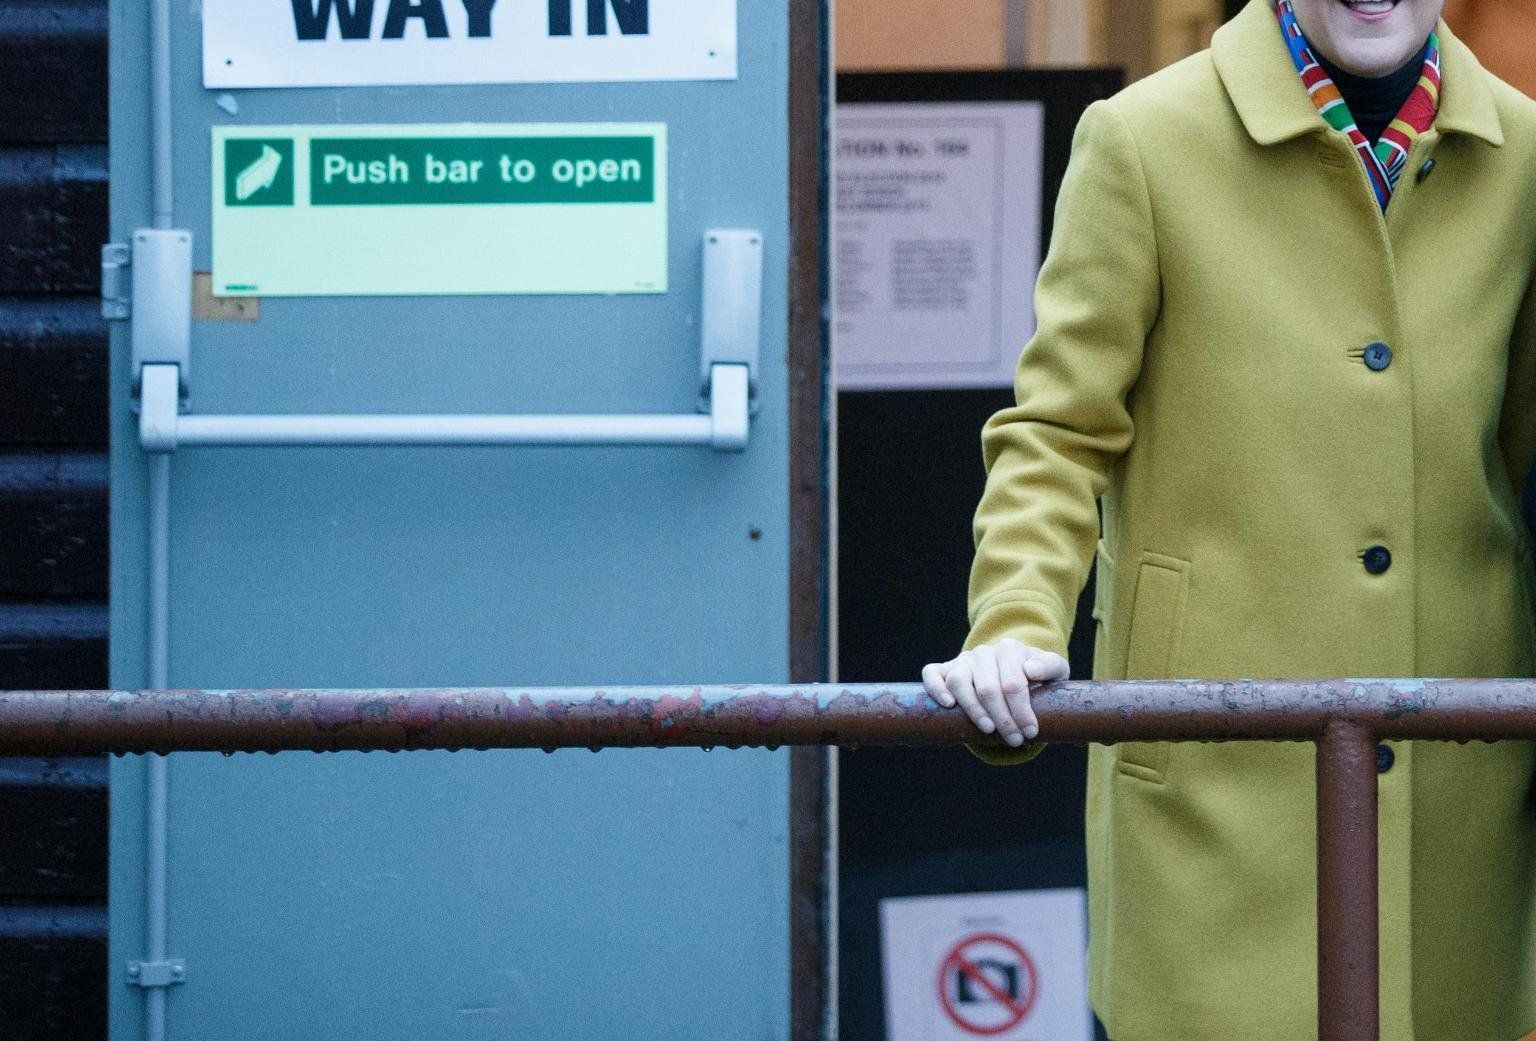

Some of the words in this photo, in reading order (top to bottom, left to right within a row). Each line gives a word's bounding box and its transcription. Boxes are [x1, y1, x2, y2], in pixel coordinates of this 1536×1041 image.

[323, 154, 409, 185] Push
[425, 154, 483, 183] bar
[499, 155, 536, 183] to
[551, 158, 642, 190] open
